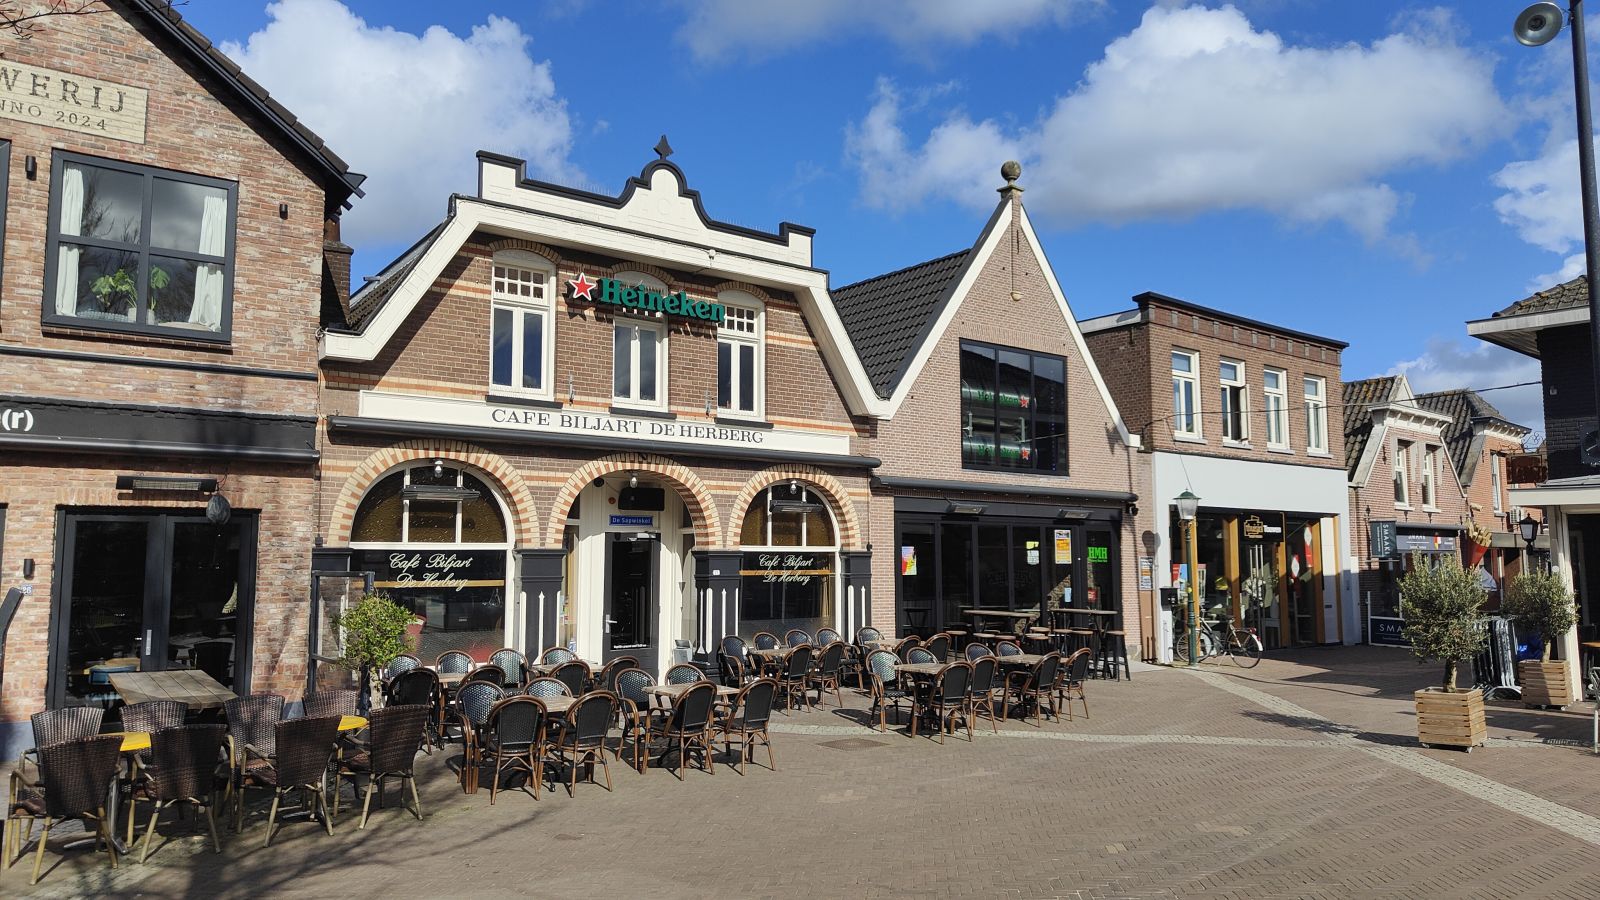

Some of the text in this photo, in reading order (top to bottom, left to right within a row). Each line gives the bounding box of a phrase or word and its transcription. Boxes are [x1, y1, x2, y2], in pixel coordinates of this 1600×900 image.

[55, 110, 107, 131] 2024
[600, 278, 726, 322] Heineken
[0, 409, 34, 431] (r)
[491, 408, 764, 444] CAFE BILJART DE HERBERG
[1382, 524, 1391, 555] SMAAKI
[389, 553, 474, 573] Café Biljart
[758, 553, 814, 570] Café Biljart
[394, 572, 469, 592] De Herberg
[763, 571, 812, 586] De Herberg
